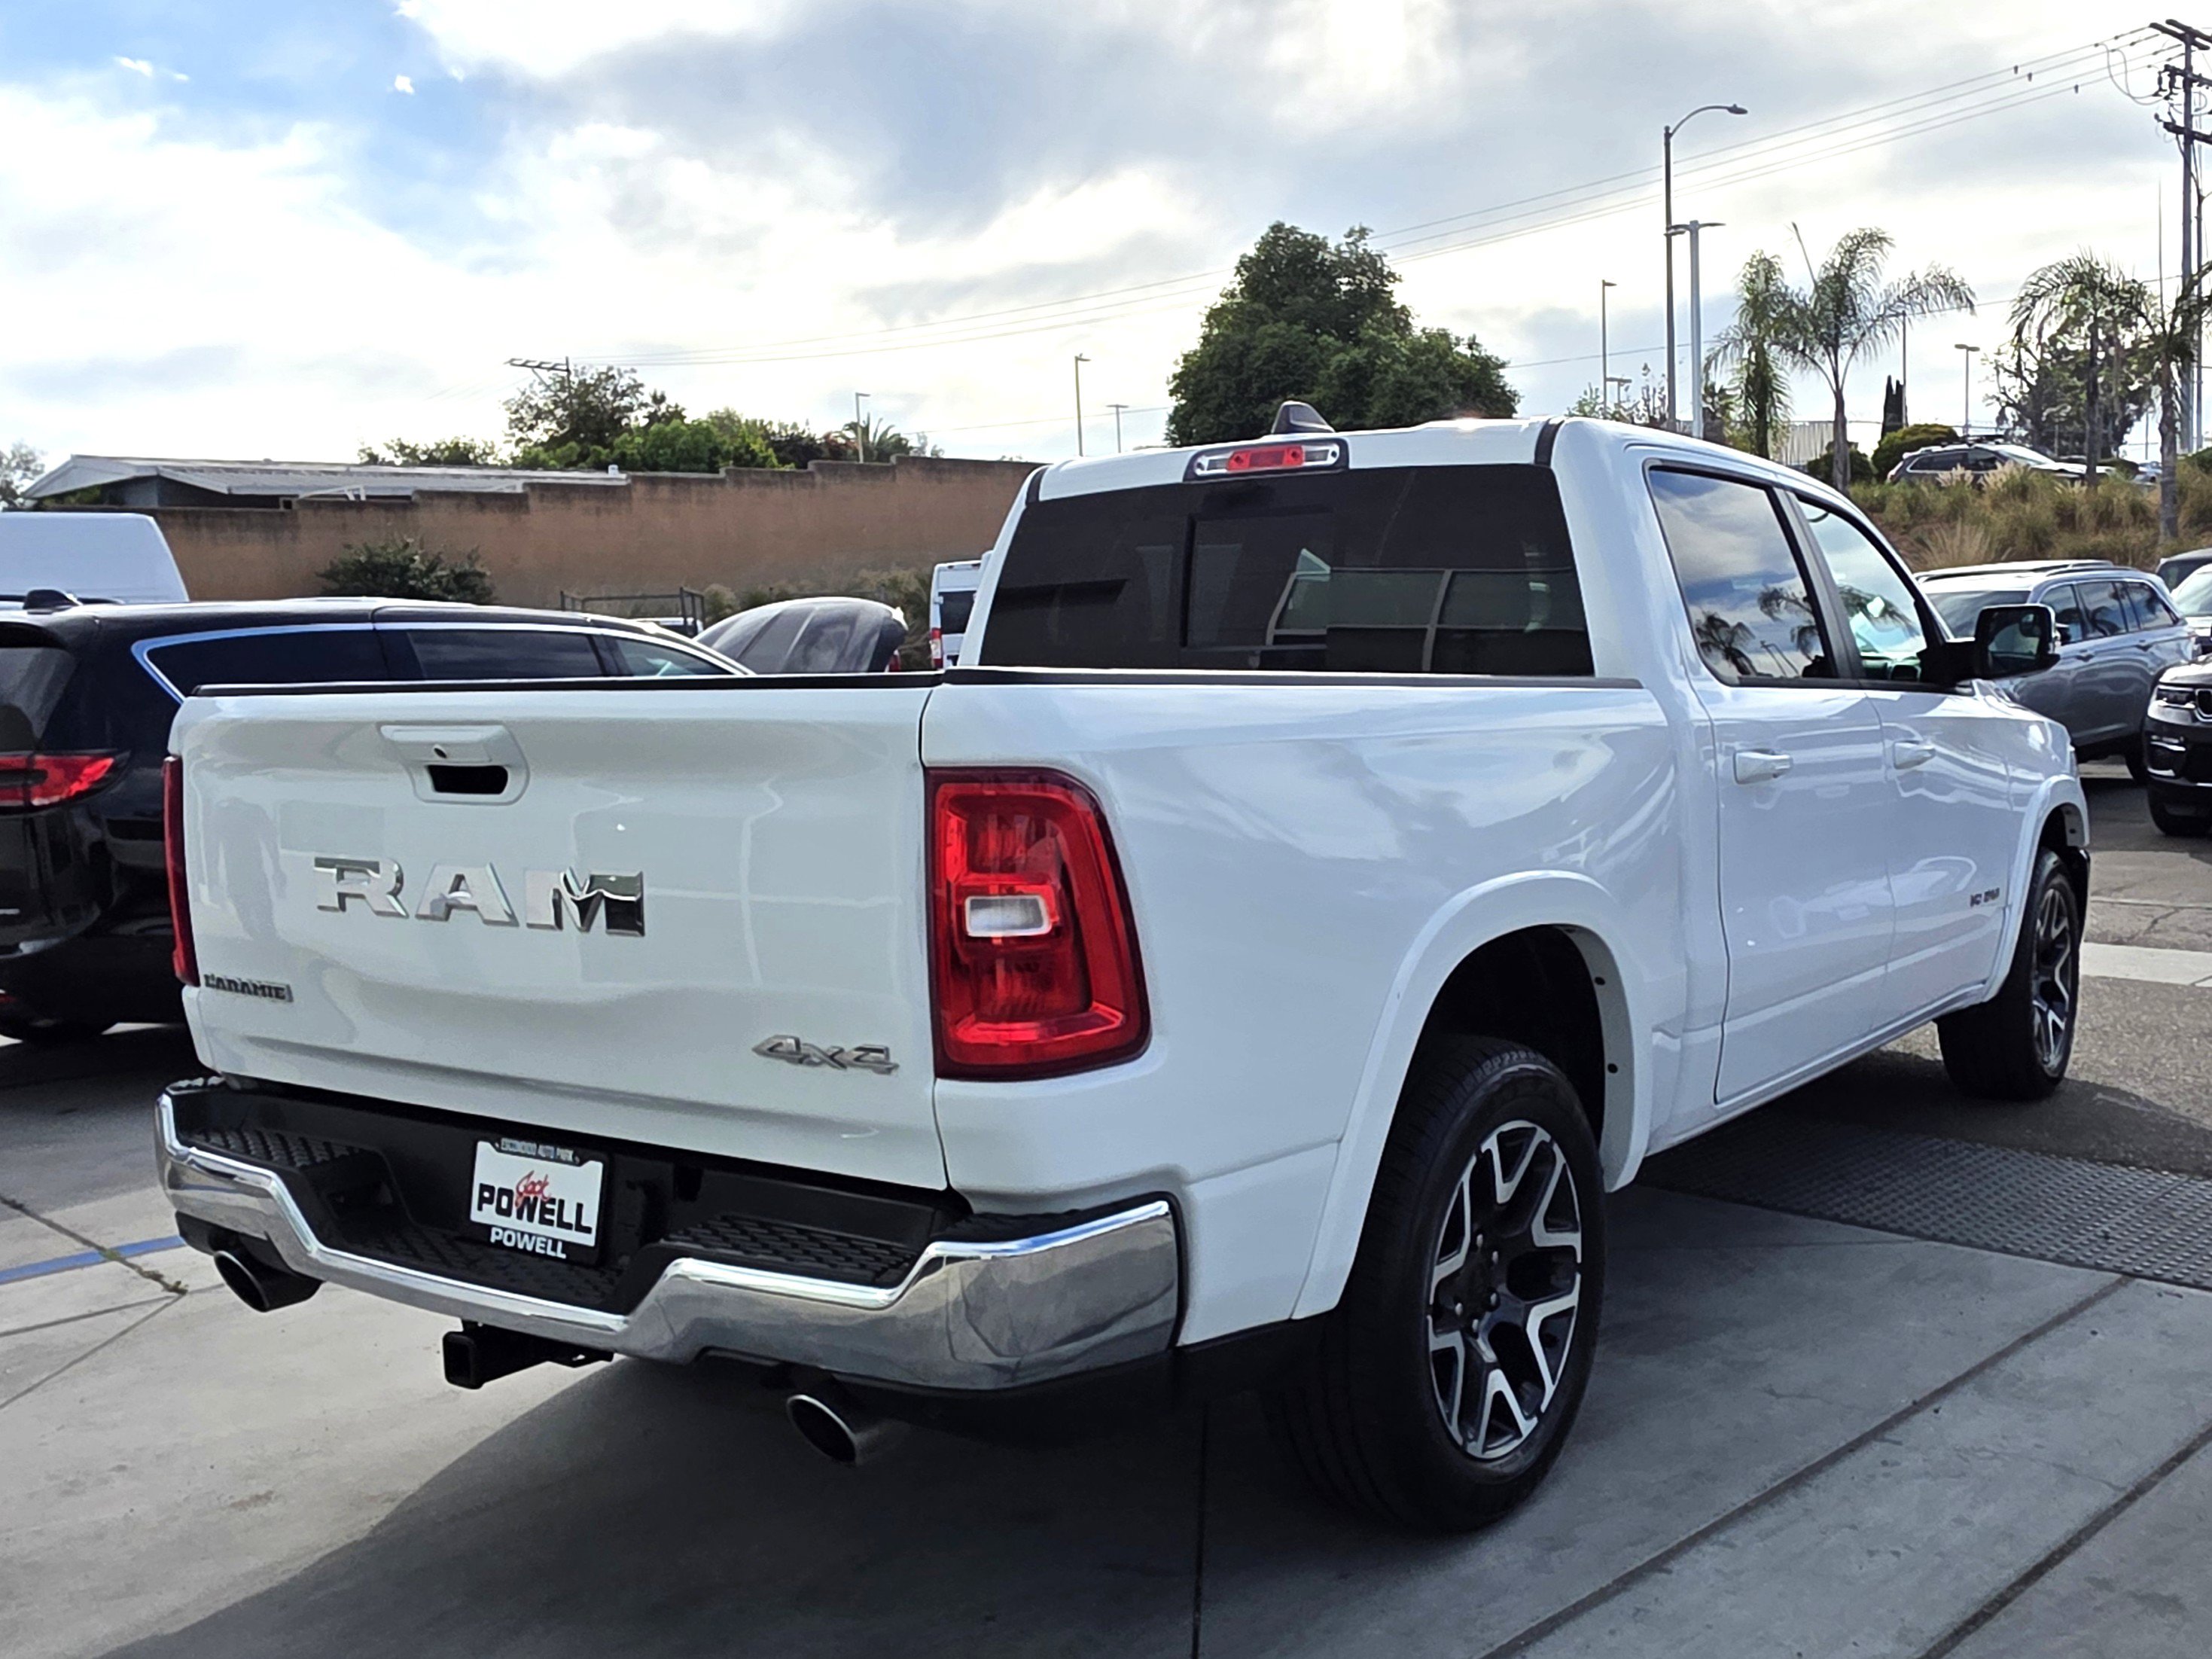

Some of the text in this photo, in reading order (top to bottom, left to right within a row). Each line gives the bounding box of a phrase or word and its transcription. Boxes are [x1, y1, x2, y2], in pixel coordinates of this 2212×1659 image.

[312, 856, 645, 937] RAM
[203, 974, 286, 1000] LARAMIE
[477, 1182, 593, 1234] POWELL
[490, 1227, 566, 1258] POWELL
